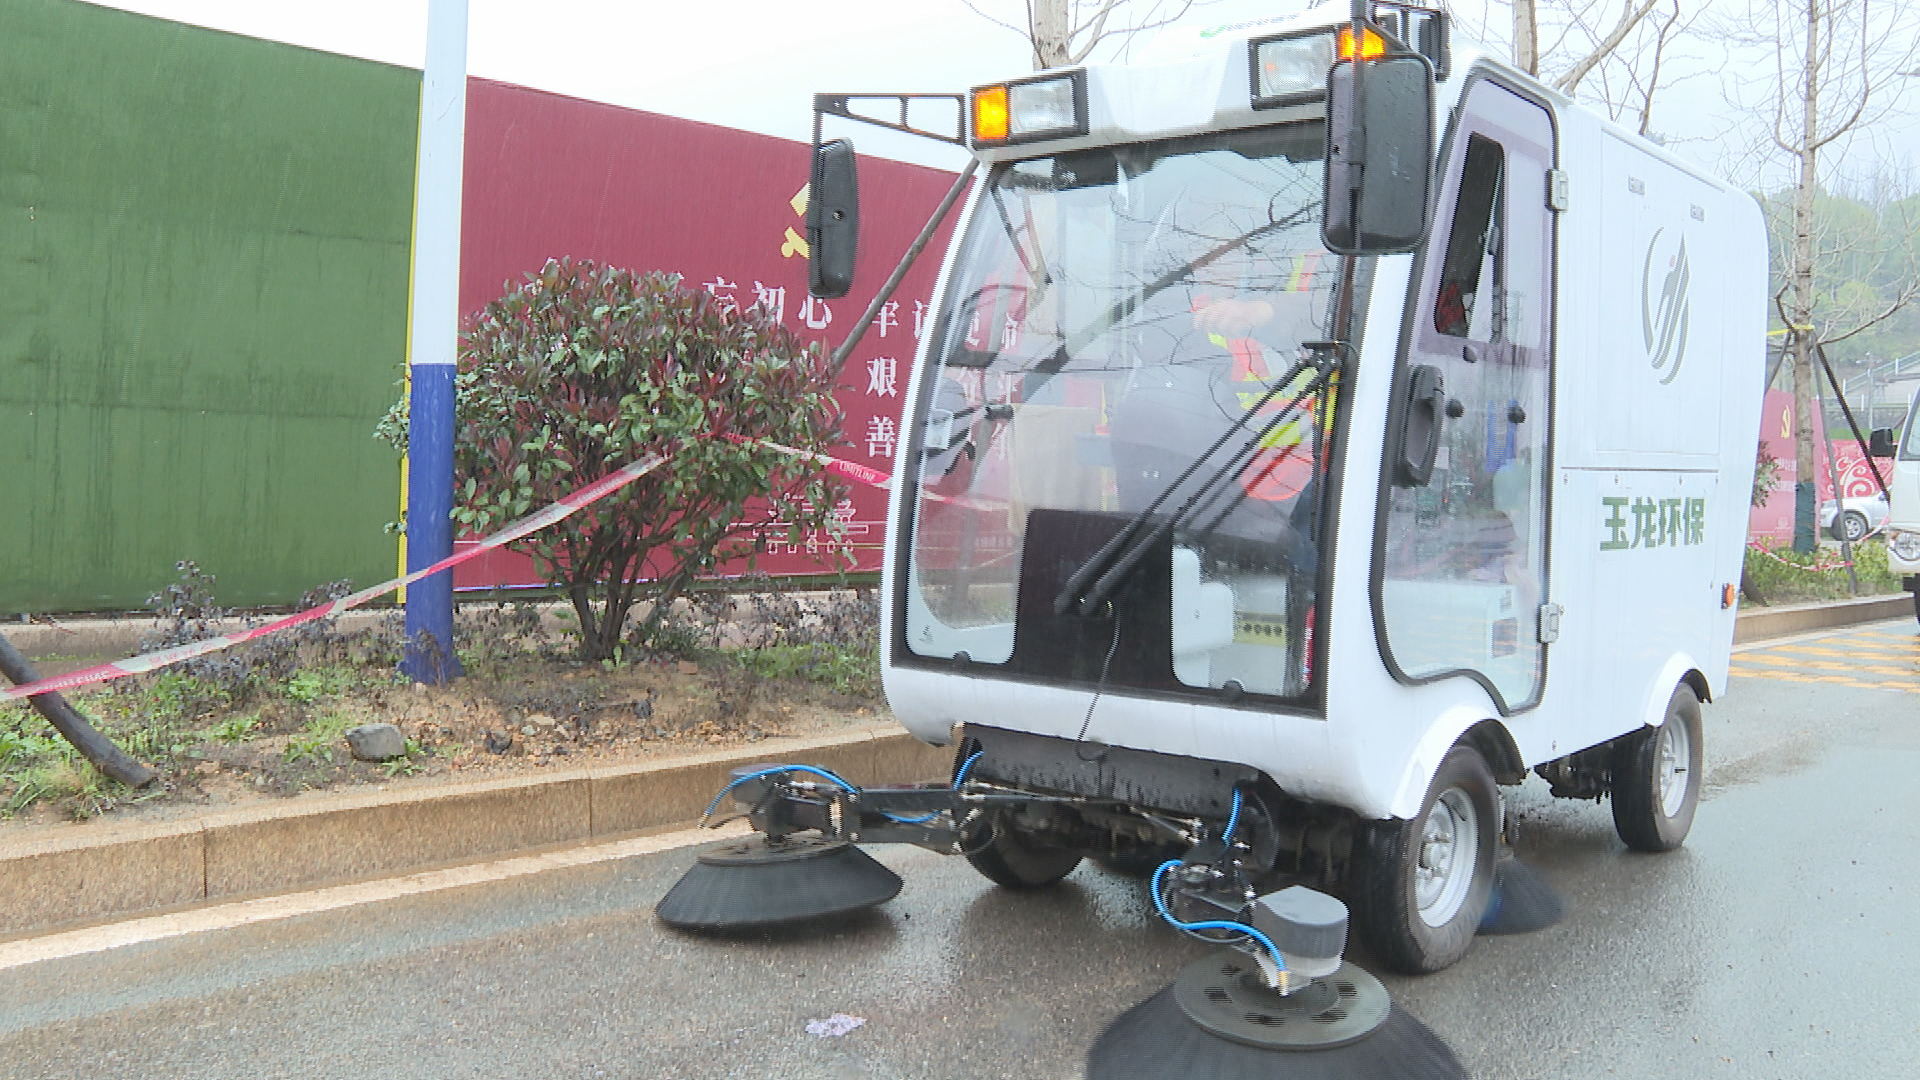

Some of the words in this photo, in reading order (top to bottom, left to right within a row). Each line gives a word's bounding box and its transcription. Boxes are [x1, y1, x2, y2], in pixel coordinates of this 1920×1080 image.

[675, 272, 833, 330] 忘初心
[864, 415, 895, 458] 善
[1599, 496, 1706, 551] 玉龙环保
